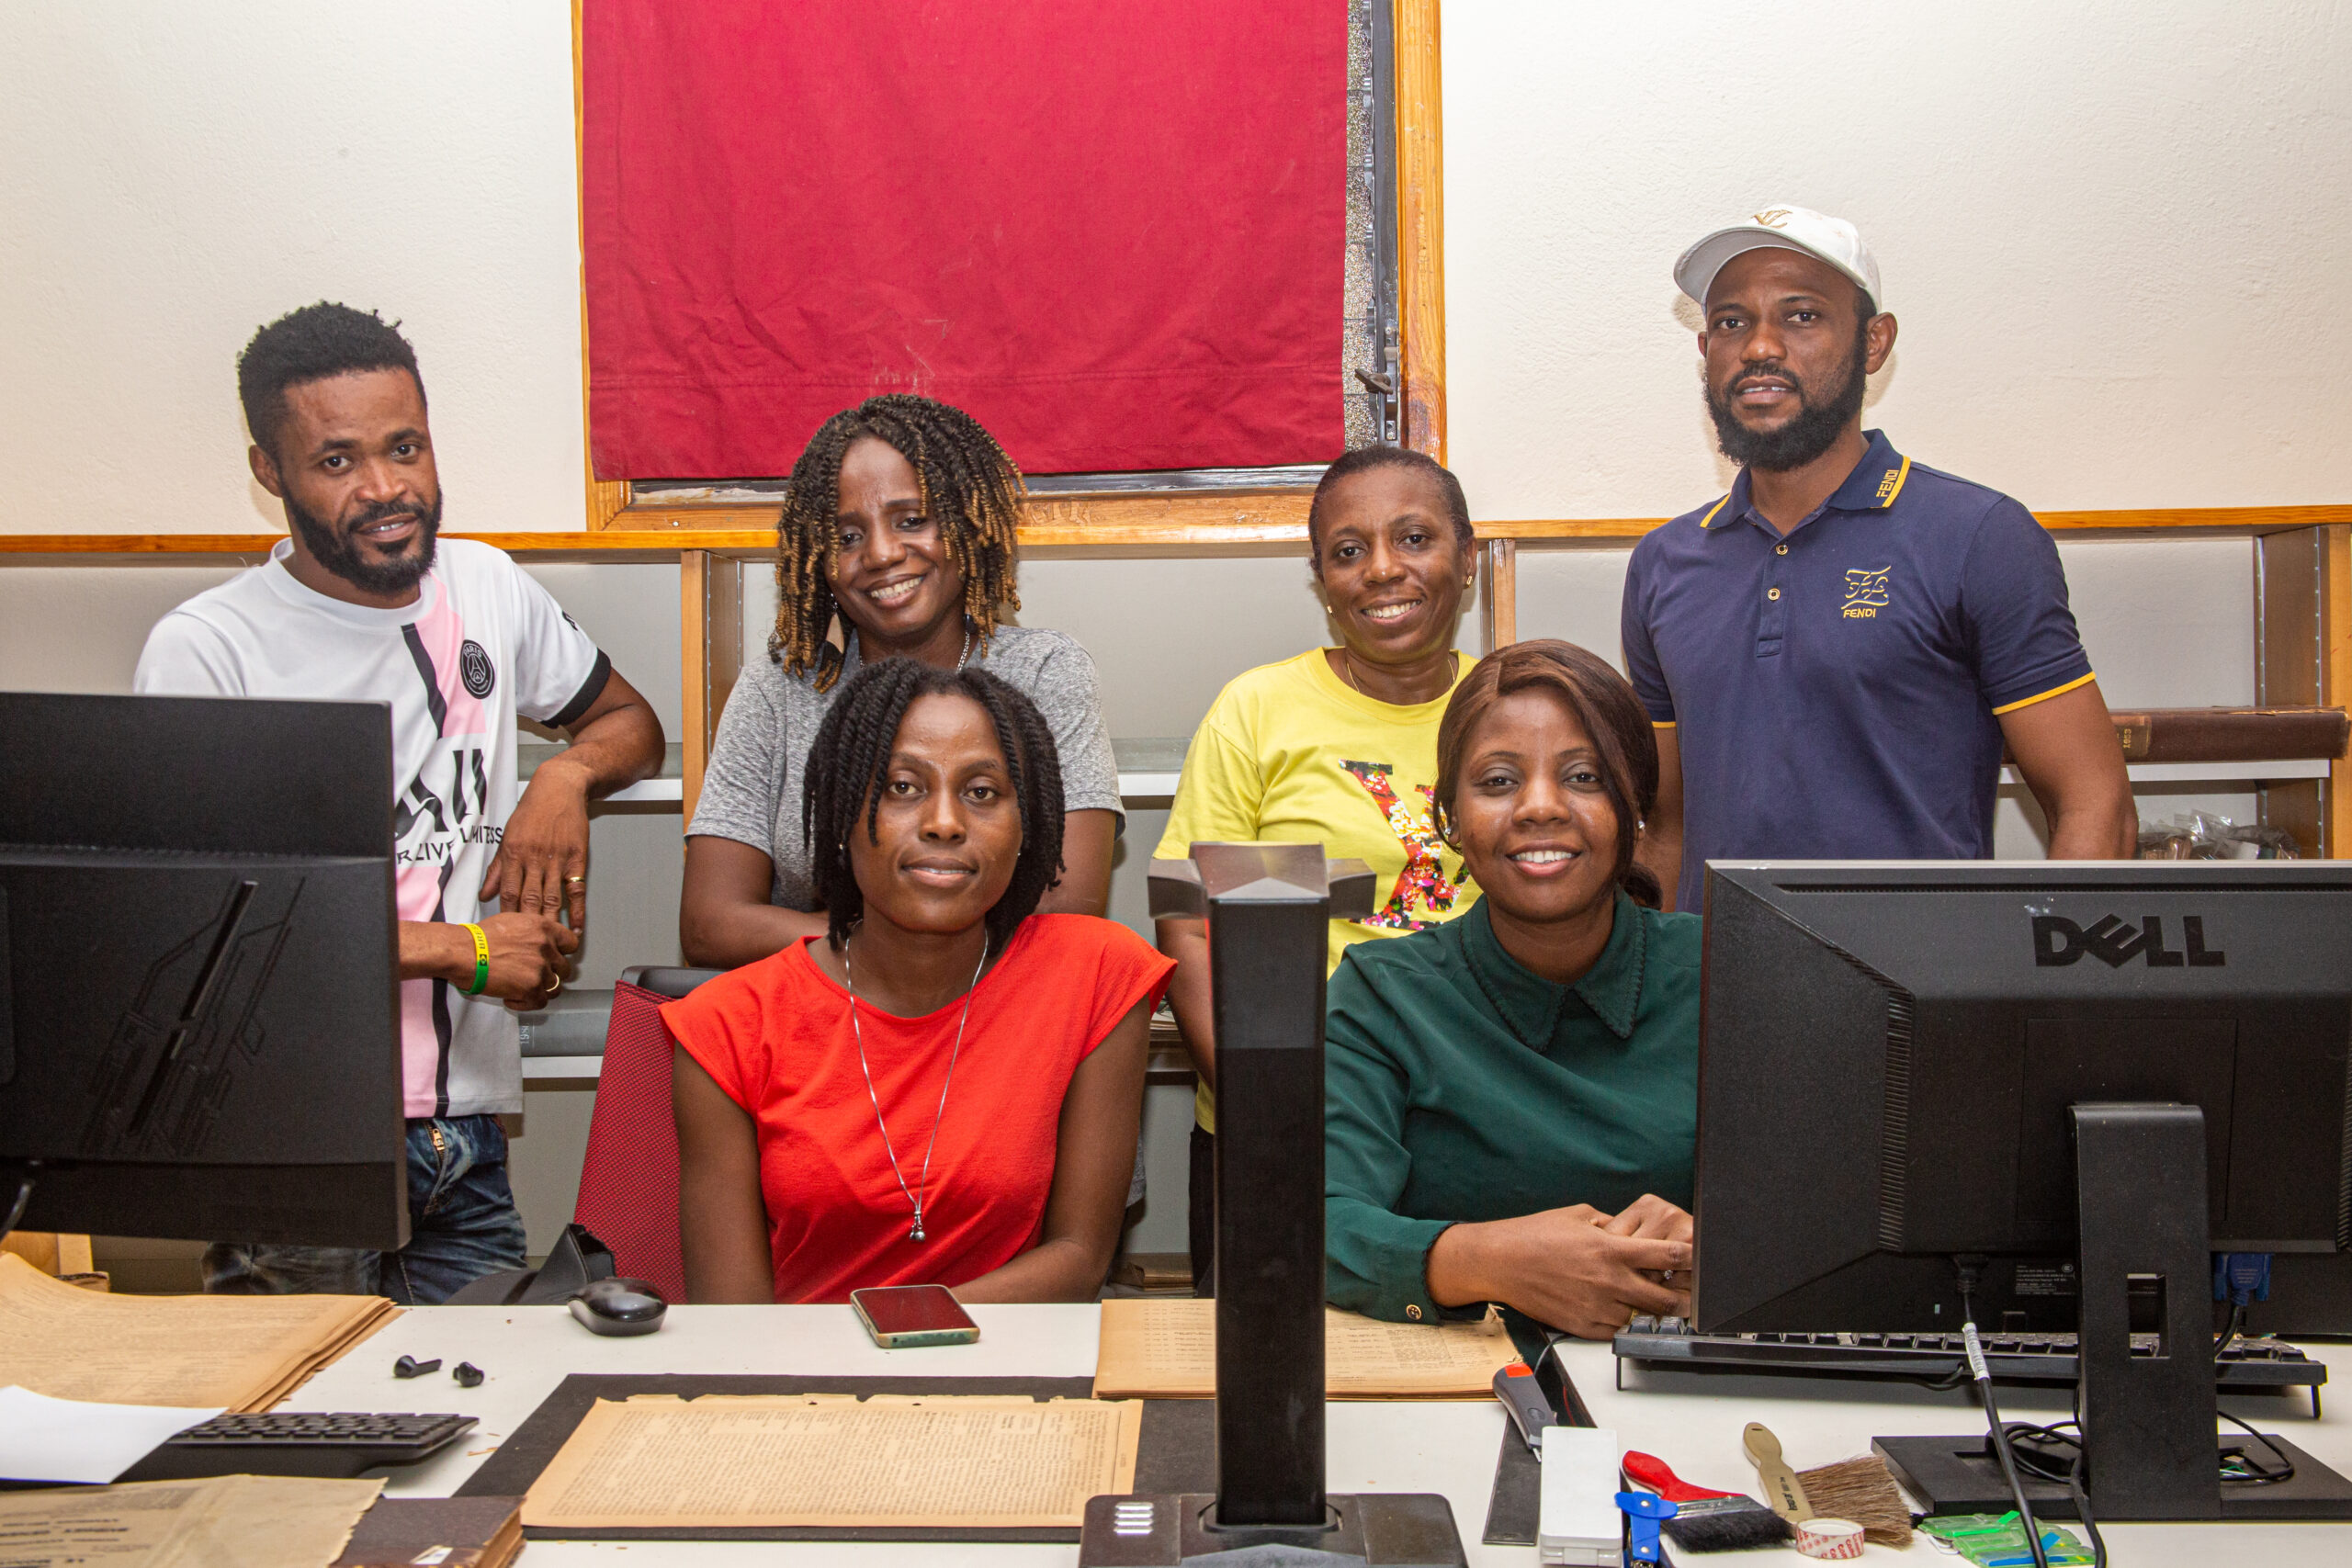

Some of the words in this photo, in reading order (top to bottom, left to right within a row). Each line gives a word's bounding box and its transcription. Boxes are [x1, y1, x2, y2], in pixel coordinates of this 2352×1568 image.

[1876, 469, 1900, 498] FENDI
[1843, 608, 1877, 618] FENDI
[463, 645, 483, 658] PARIS
[2030, 912, 2226, 969] DELL
